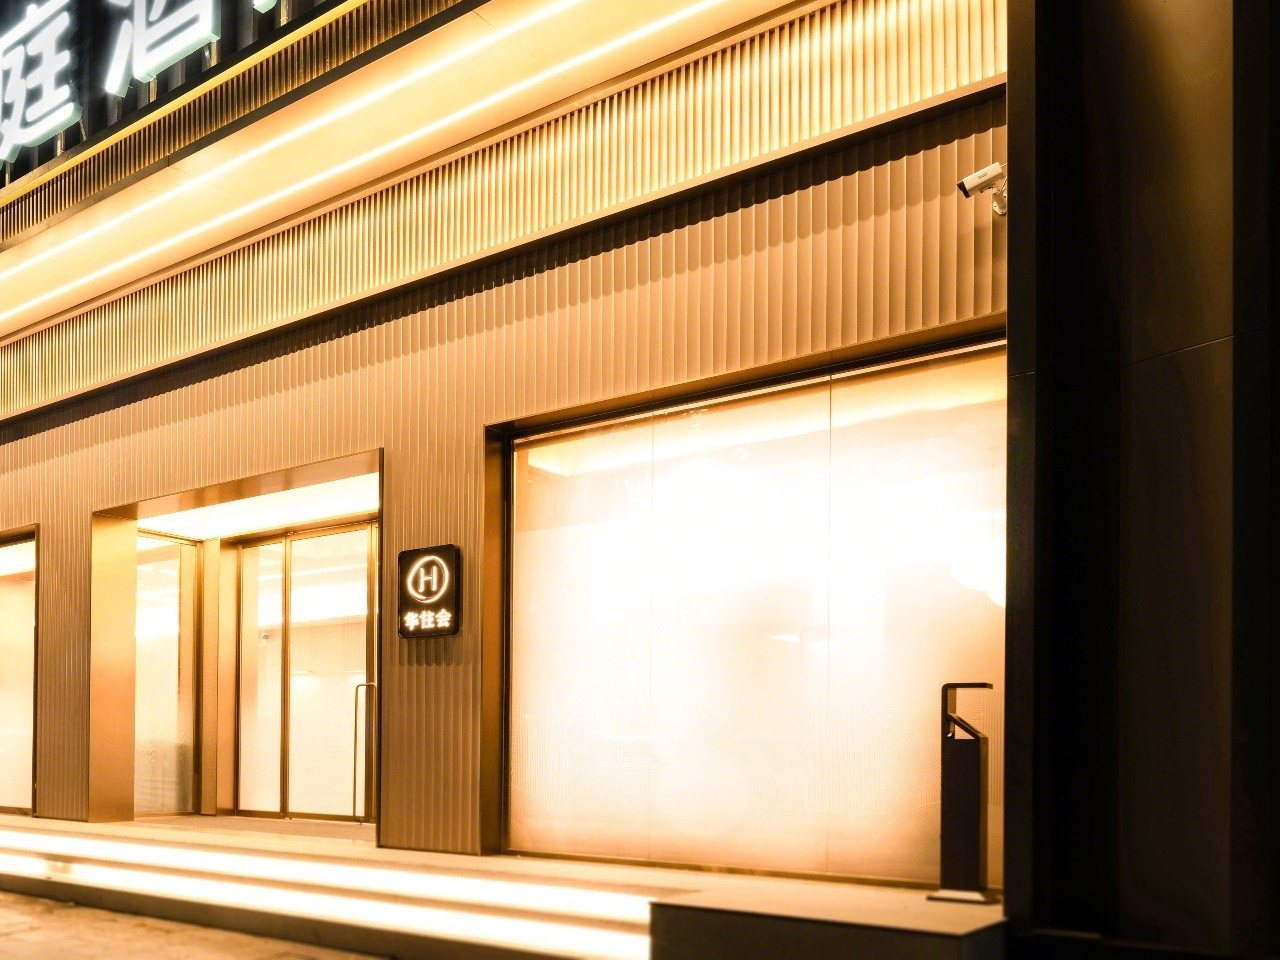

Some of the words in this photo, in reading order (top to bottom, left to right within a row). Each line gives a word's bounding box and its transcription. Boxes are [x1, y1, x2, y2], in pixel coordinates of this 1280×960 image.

[418, 565, 438, 593] H
[403, 608, 452, 631] 华住会
